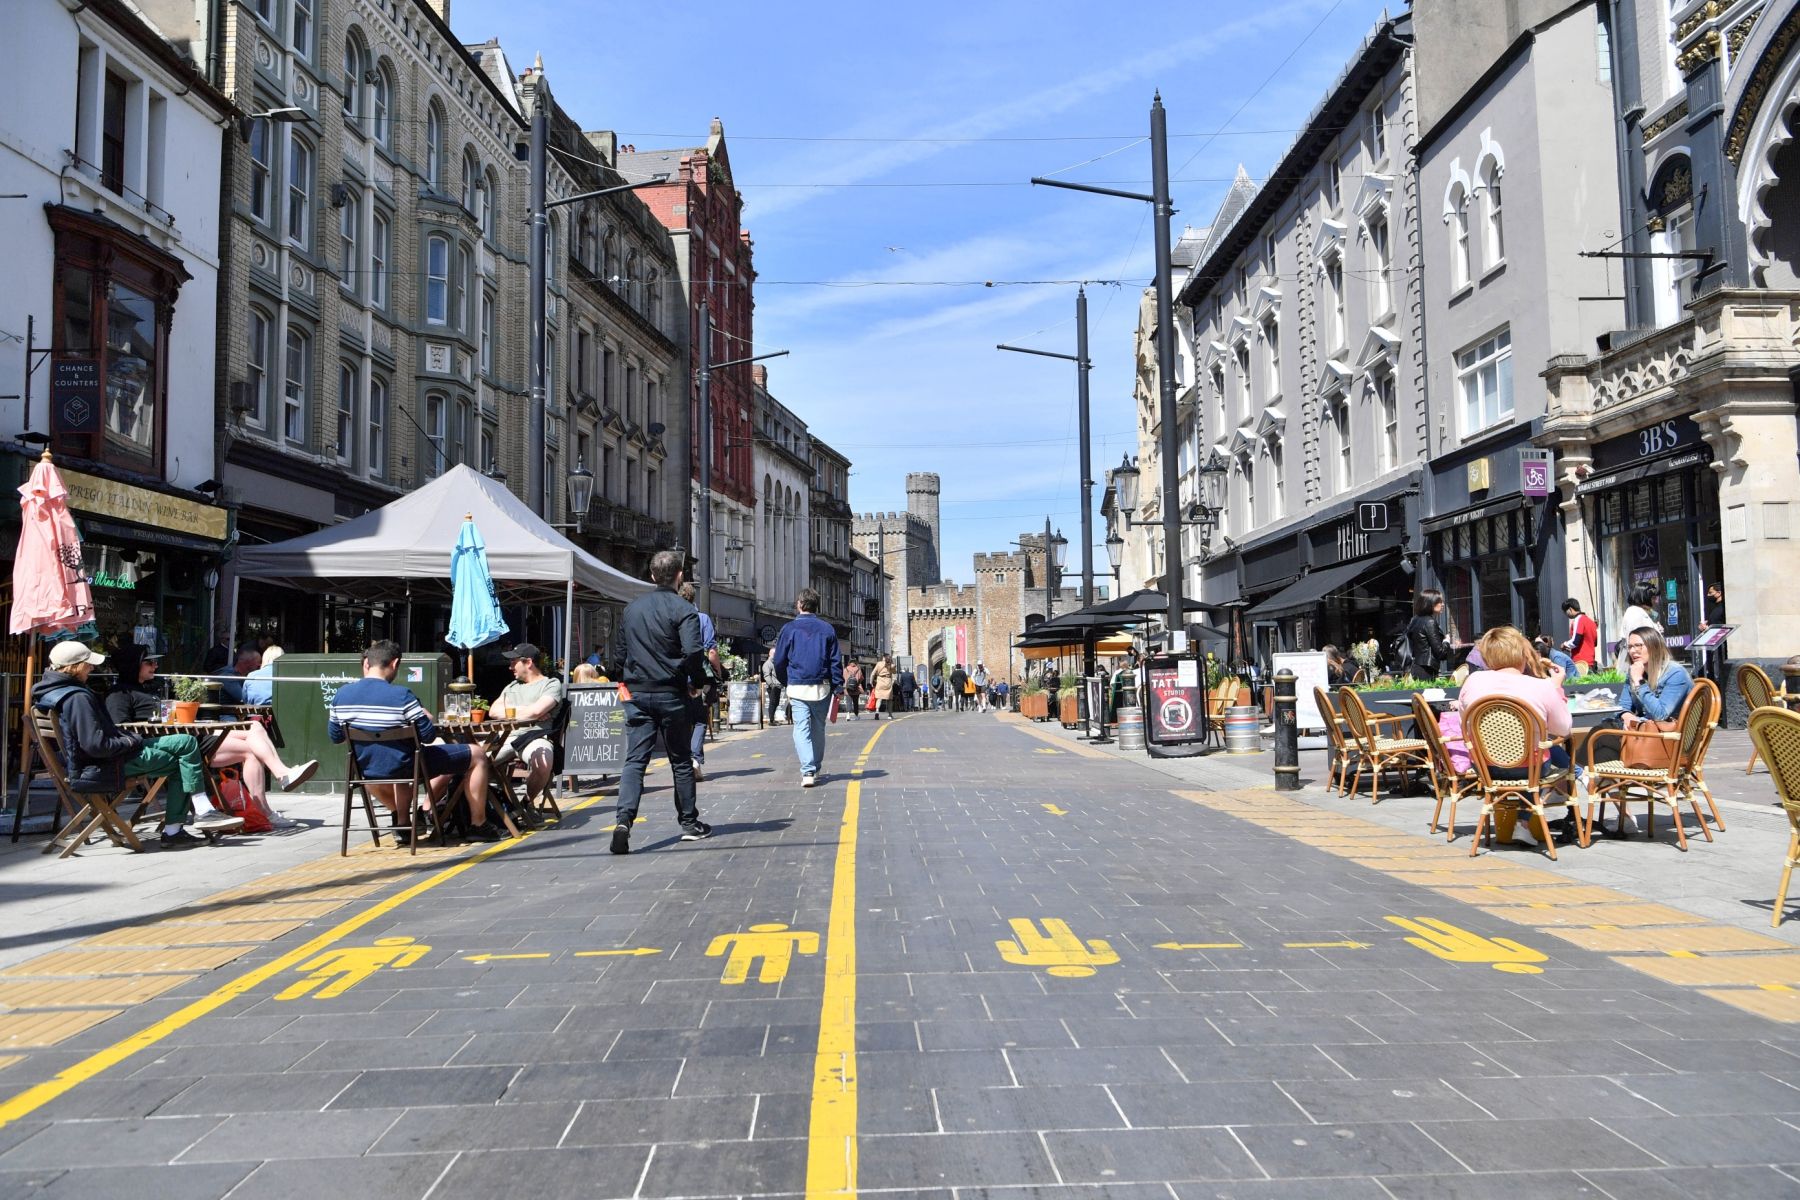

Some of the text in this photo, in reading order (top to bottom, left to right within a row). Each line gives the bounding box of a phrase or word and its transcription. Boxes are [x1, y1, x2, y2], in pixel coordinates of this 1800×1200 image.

[1640, 420, 1678, 456] 3B'S
[68, 484, 199, 524] PREGO ITALIAN WINE BAR
[94, 570, 115, 587] Wine
[116, 573, 136, 589] Bar
[1666, 636, 1684, 647] FOOD
[1151, 679, 1180, 689] TATT
[1163, 689, 1185, 697] STUDIO
[570, 691, 619, 707] TAKEAWAY
[583, 711, 608, 722] BEERS
[583, 721, 605, 729] CIDERS
[583, 728, 609, 739] SLUSHIES
[570, 744, 620, 762] AVAILABLE
